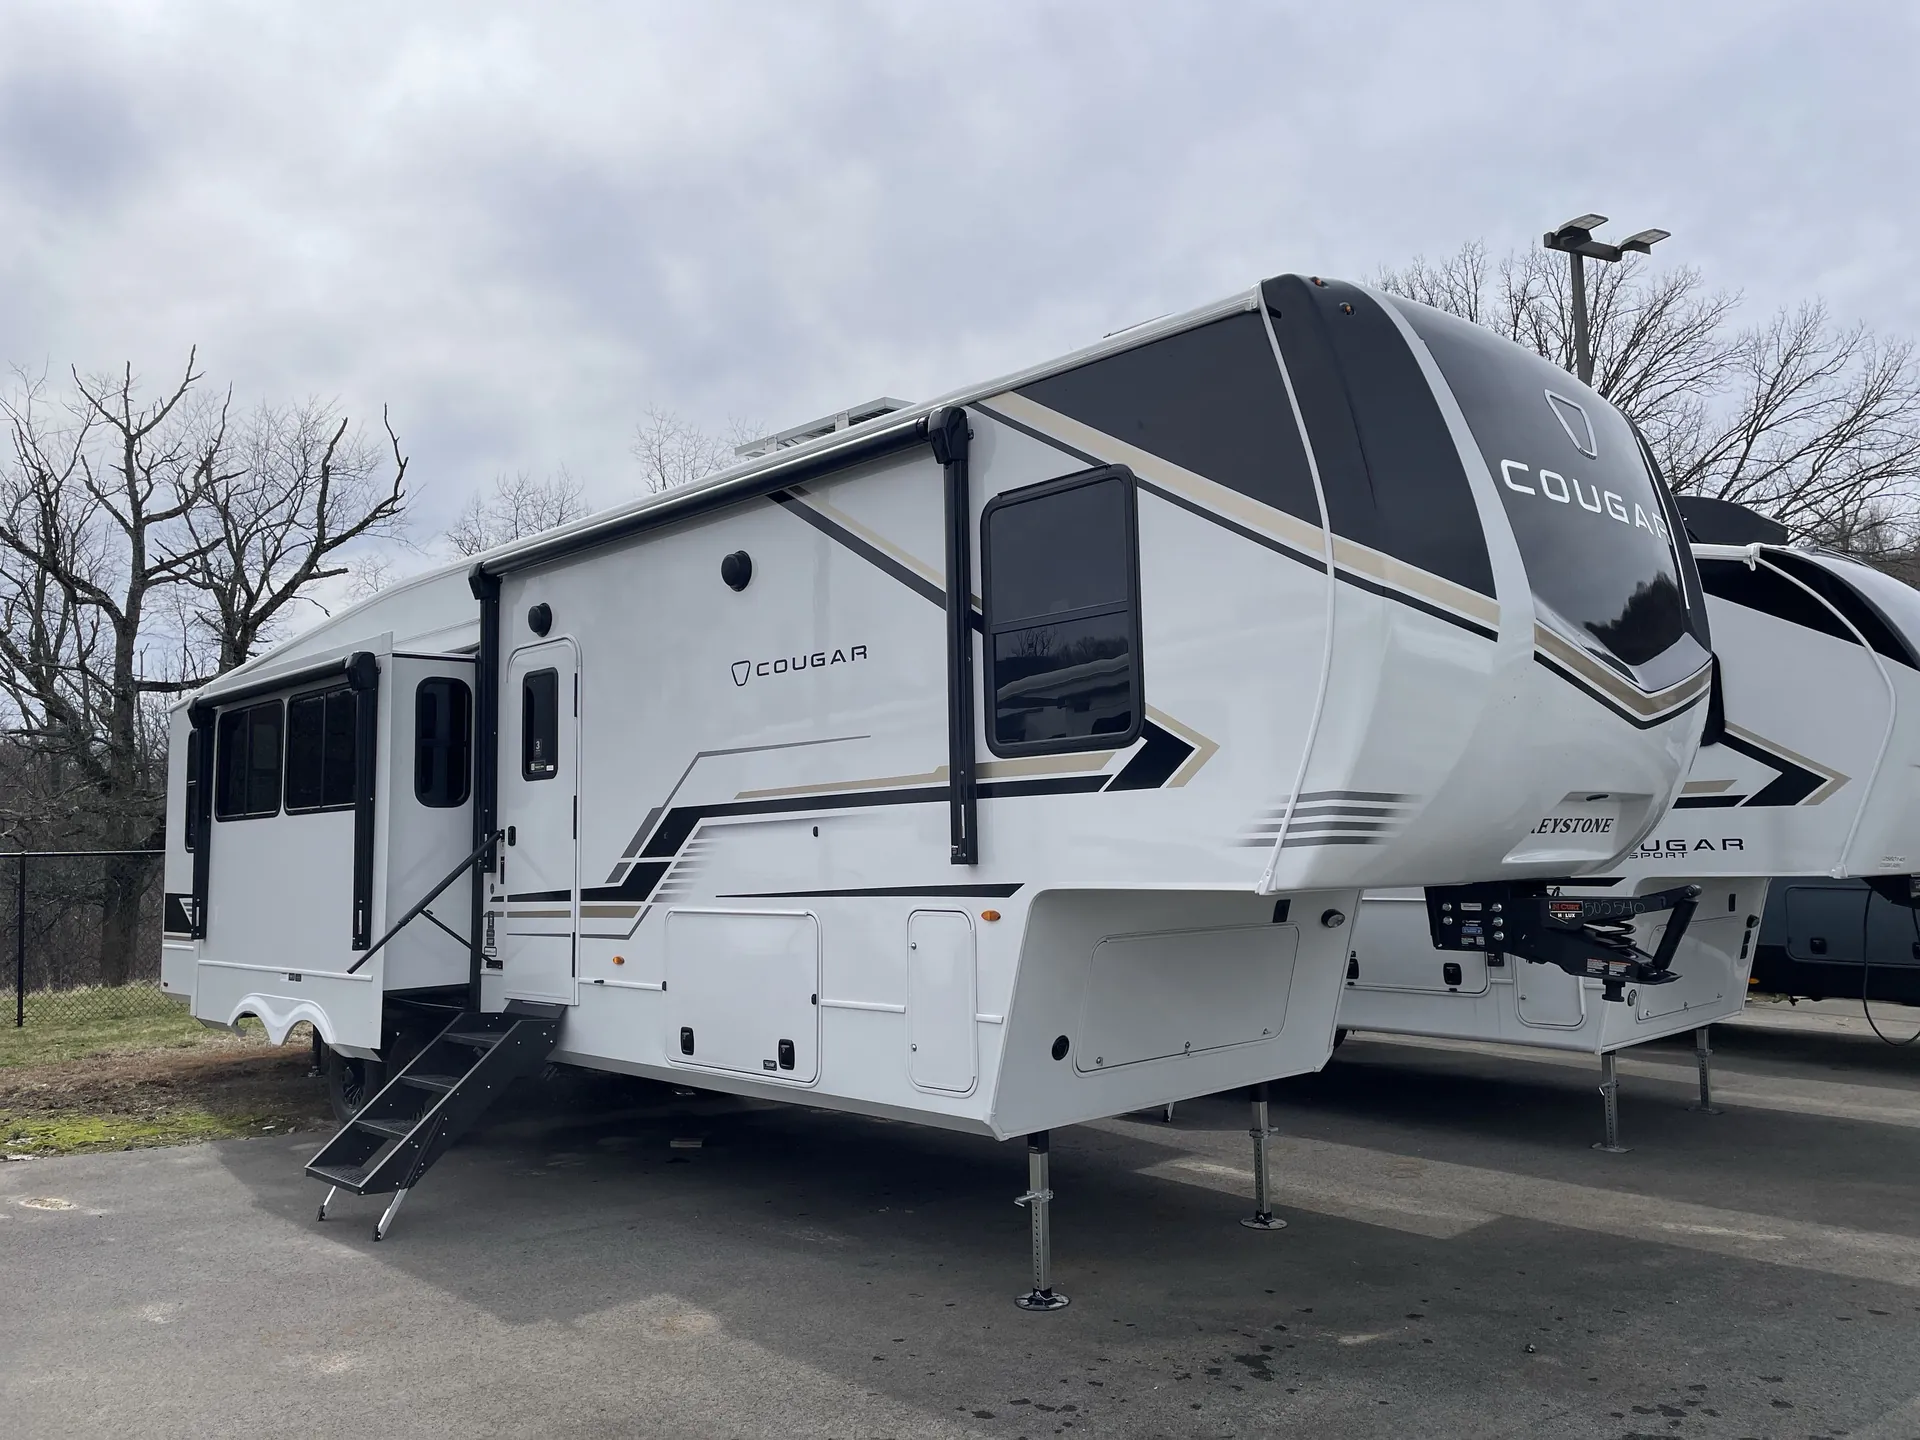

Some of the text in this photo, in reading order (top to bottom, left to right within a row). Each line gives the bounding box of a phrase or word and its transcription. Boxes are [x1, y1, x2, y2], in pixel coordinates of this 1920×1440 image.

[1501, 459, 1672, 545] COUGAR
[756, 644, 867, 676] COUGAR
[1531, 818, 1614, 834] EYSTONE
[1640, 838, 1744, 852] UGAR
[1629, 851, 1688, 859] SPORT
